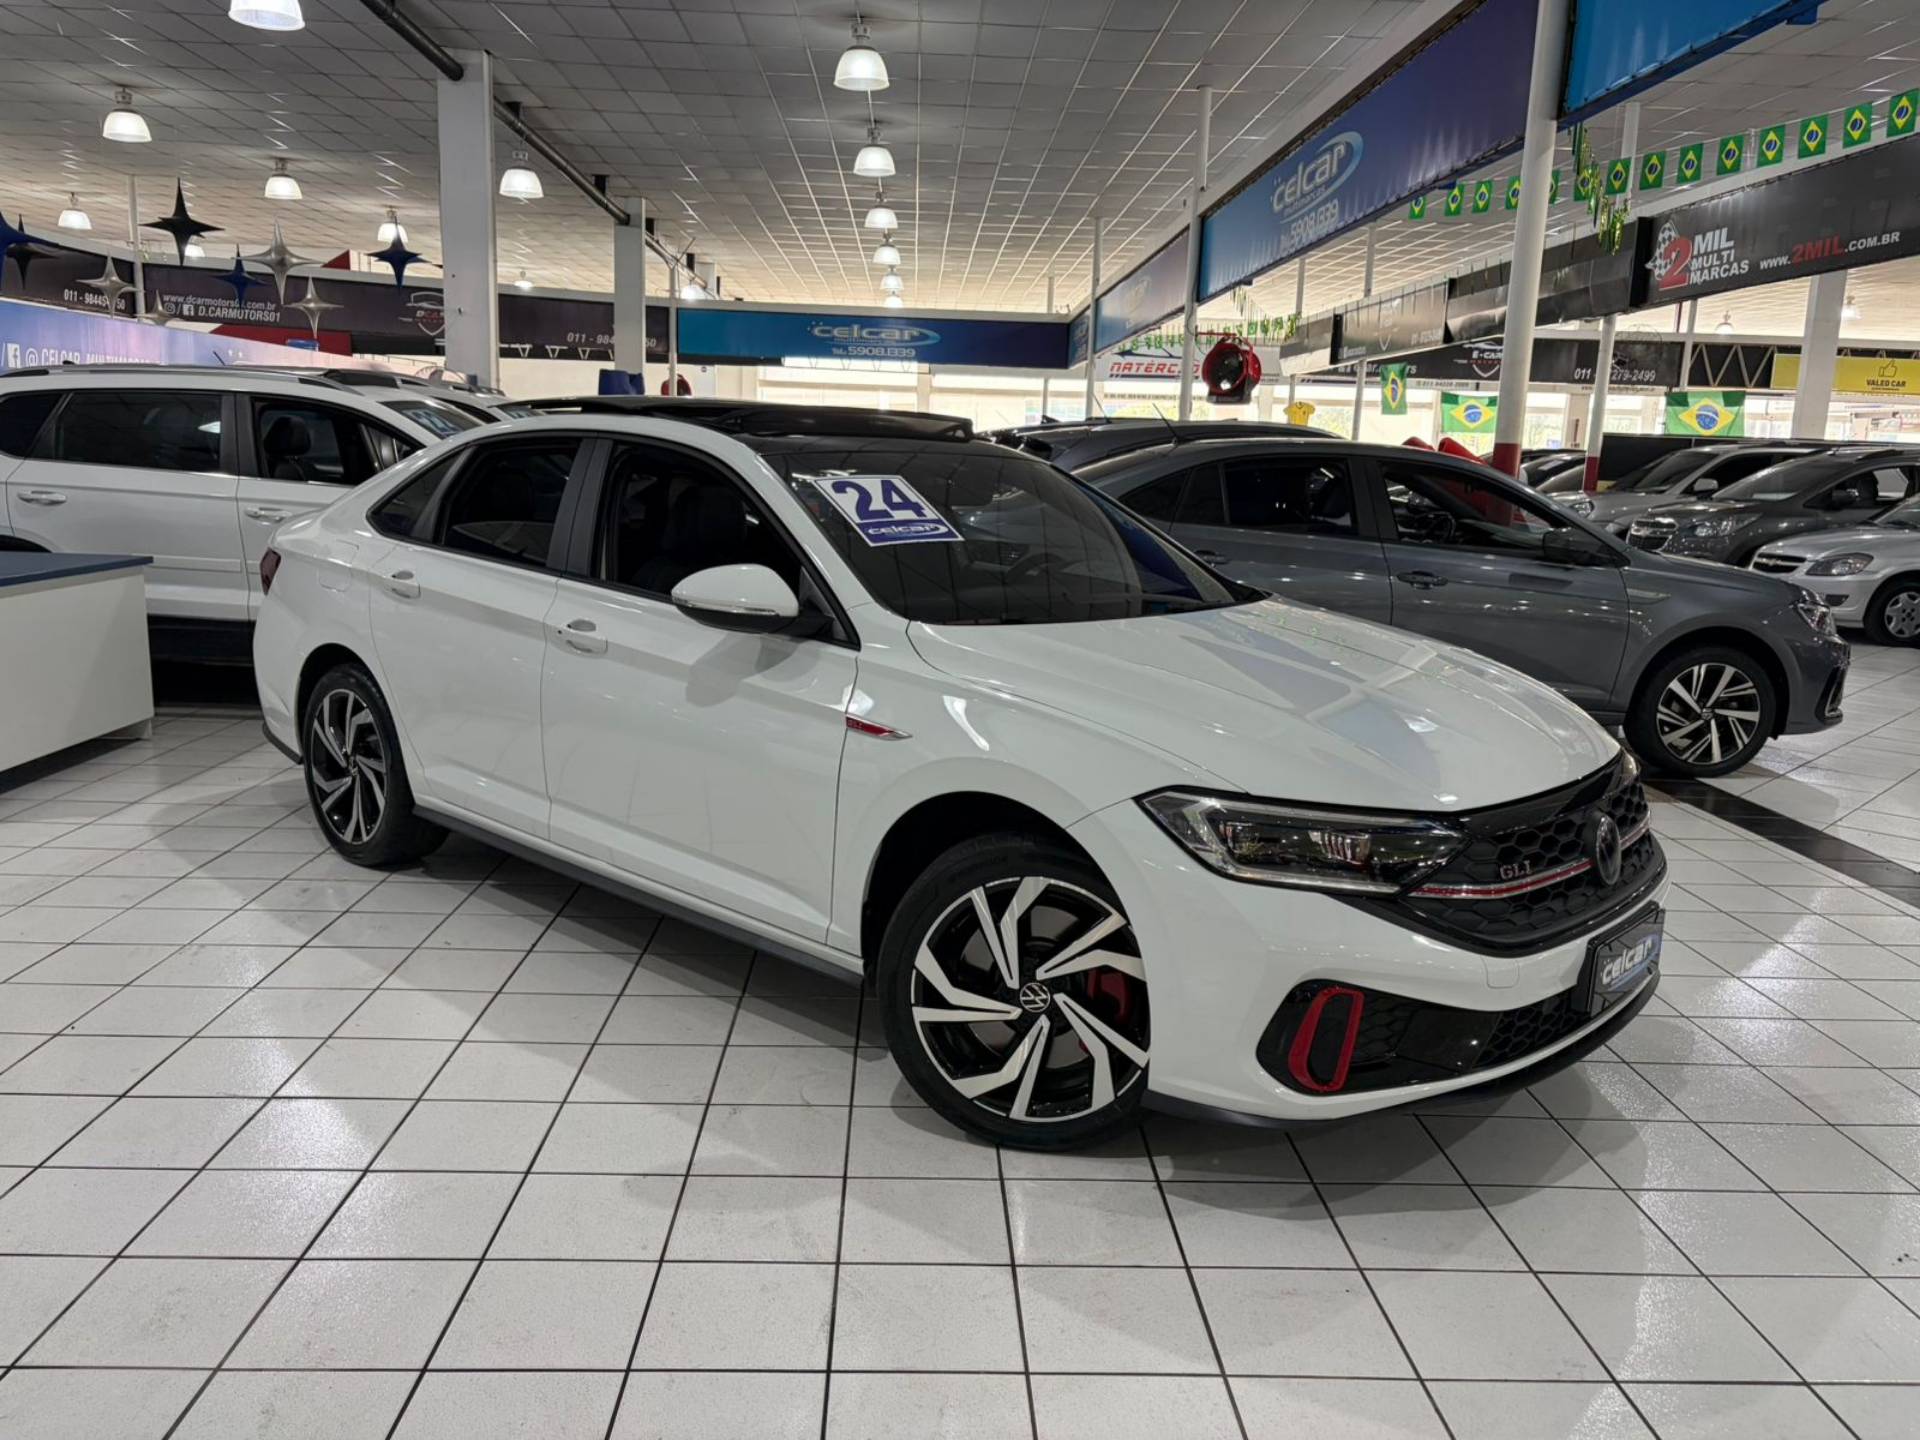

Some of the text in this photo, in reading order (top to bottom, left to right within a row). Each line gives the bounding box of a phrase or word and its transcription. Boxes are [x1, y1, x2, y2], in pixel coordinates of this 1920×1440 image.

[1273, 142, 1346, 213] celcar
[1693, 227, 1735, 256] MIL
[1690, 249, 1735, 271] MULTI
[1689, 259, 1750, 285] MARCAS
[63, 288, 78, 302] 011
[162, 293, 277, 311] www.dcarmotors0.com.br
[198, 305, 281, 322] D.CARMOTORS01
[567, 332, 587, 344] 011
[812, 323, 921, 342] celcar
[1574, 368, 1591, 379] 011
[1891, 379, 1907, 388] CAR
[831, 479, 927, 521] 24
[1500, 860, 1533, 880] GLI
[1601, 938, 1654, 986] celcar
